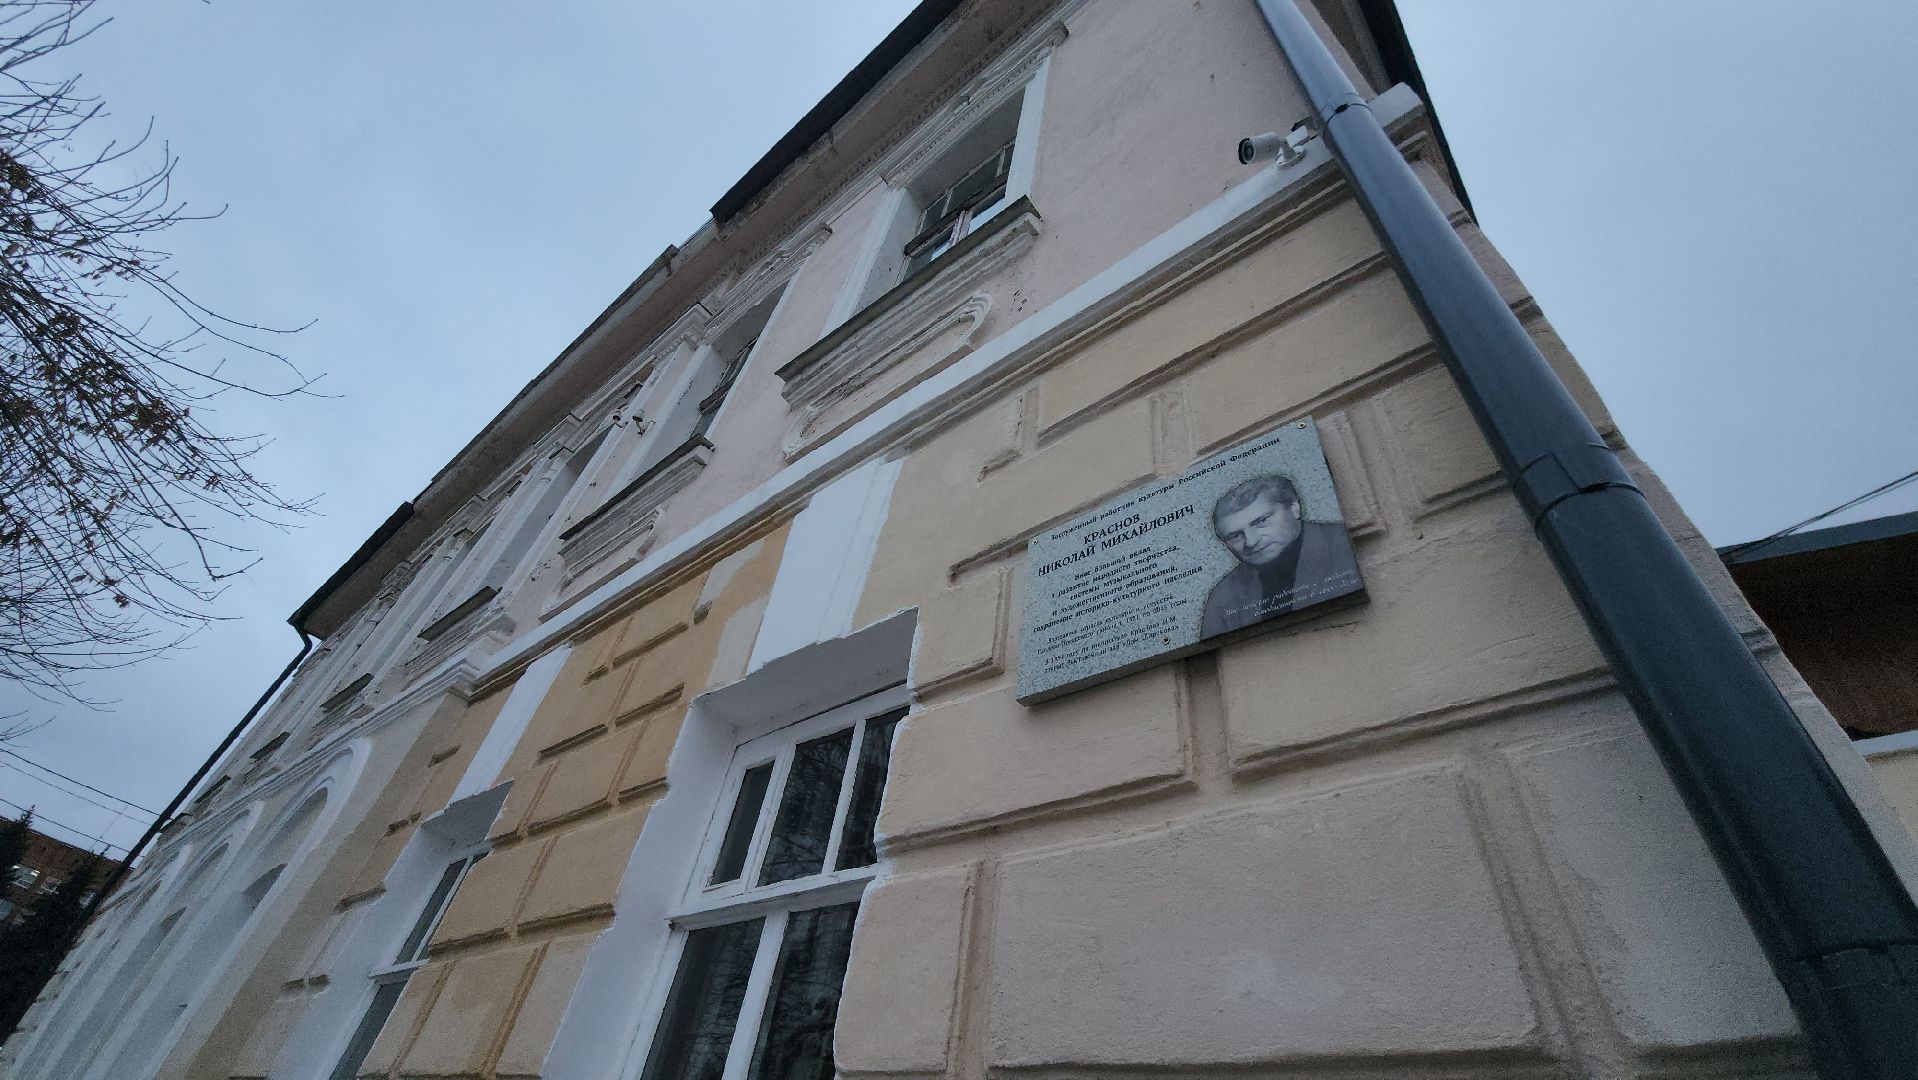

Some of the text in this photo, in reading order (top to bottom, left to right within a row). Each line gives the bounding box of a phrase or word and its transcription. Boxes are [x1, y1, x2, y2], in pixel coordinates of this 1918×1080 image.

[1138, 482, 1174, 503] культуры
[1178, 459, 1226, 486] Российской
[1229, 435, 1280, 463] Федерации
[1038, 502, 1194, 576] НИКОЛАЙ МИХАЙЛОВИЧ
[1083, 513, 1140, 544] КРАСНОВ
[1070, 562, 1157, 600] системы музыкального
[1092, 563, 1130, 583] народного
[1033, 613, 1072, 633] сохранение
[1164, 565, 1202, 585] наследия
[1060, 585, 1122, 614] художественного
